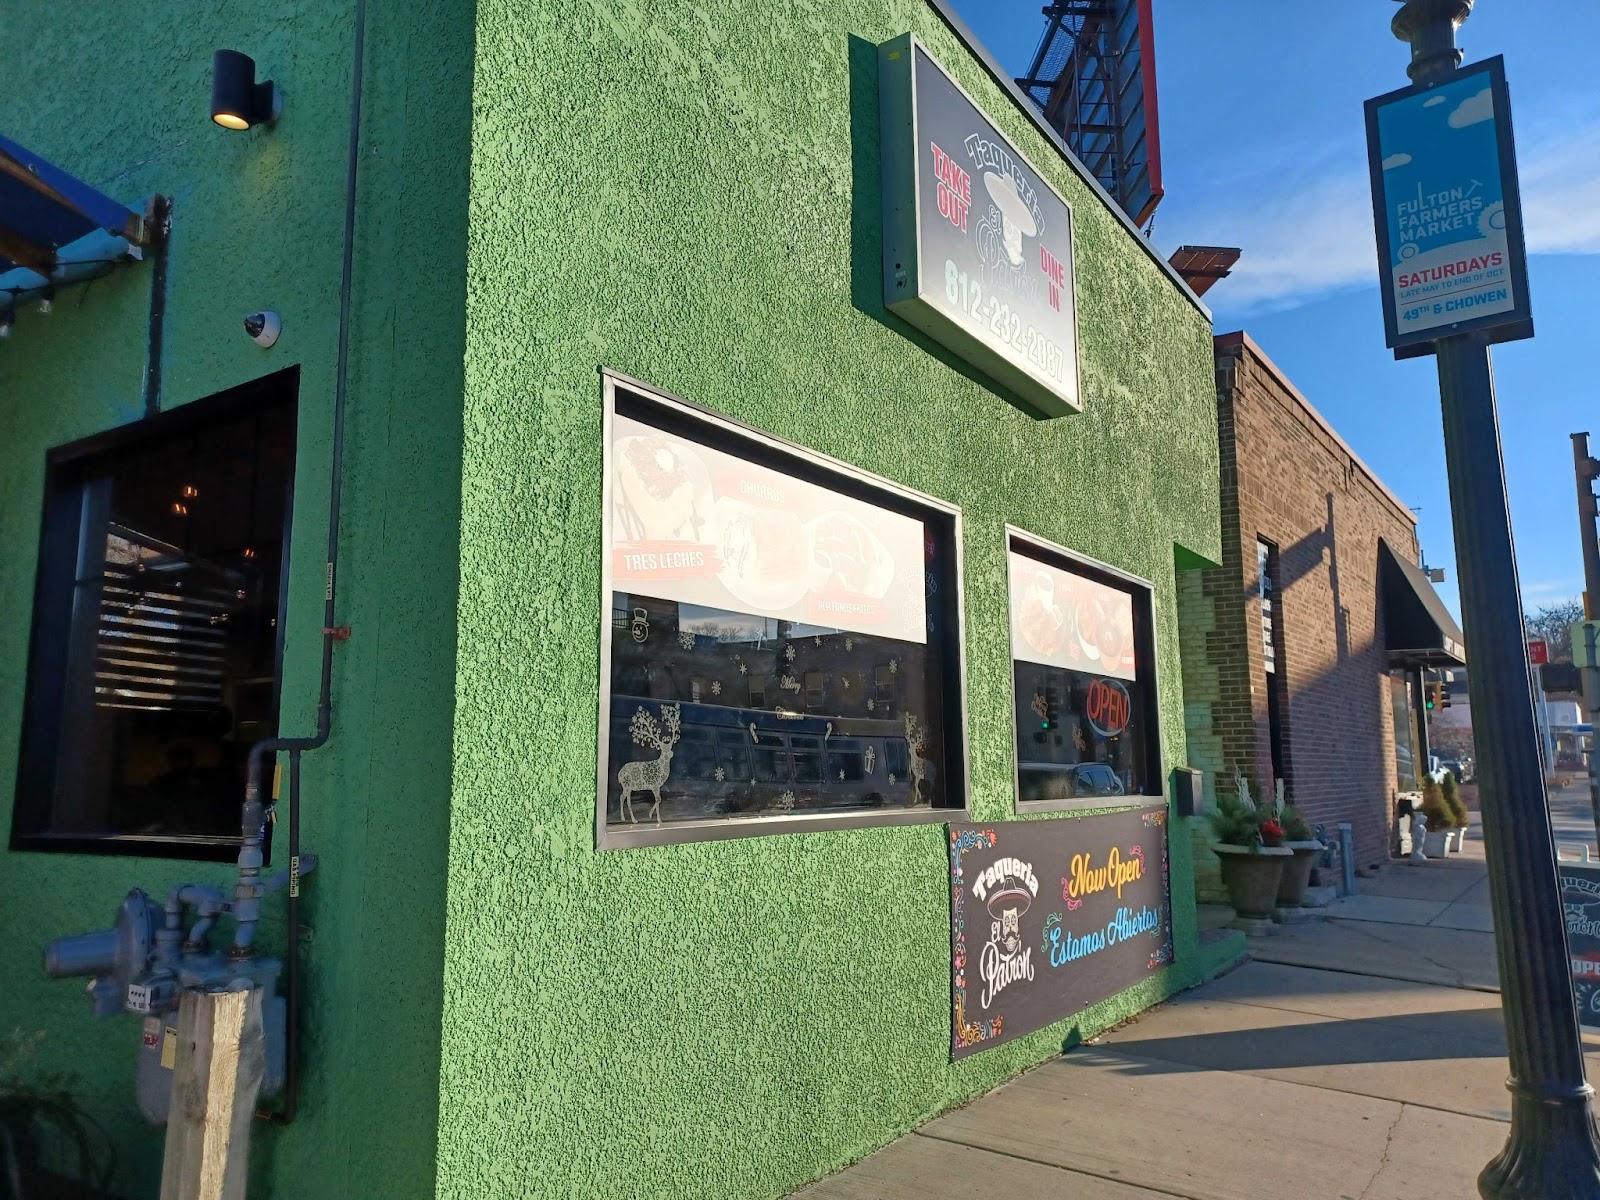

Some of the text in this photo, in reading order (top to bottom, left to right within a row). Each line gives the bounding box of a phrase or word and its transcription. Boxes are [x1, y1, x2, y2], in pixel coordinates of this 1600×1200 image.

[931, 142, 971, 205] TAKE
[964, 133, 1045, 236] Taqueria
[937, 181, 969, 234] OUT
[1398, 182, 1463, 216] FULTON
[1398, 196, 1482, 230] FARMERS
[1400, 212, 1475, 244] MARKET
[1040, 243, 1065, 290] DINE
[1398, 252, 1503, 288] SATURDAYS
[1400, 268, 1505, 299] LATE MAY TO END OF OCT
[1048, 280, 1060, 312] IN
[1445, 288, 1507, 312] CHOWEN
[944, 259, 1063, 383] 612-232-2087
[624, 551, 704, 571] TRES LECHES
[1087, 679, 1127, 732] OPEN
[972, 857, 1039, 901] Taqueria
[1069, 847, 1141, 899] Now Open
[991, 921, 1001, 942] El
[1050, 905, 1158, 967] Estamos Abiertos
[979, 941, 1035, 1009] Patrón
